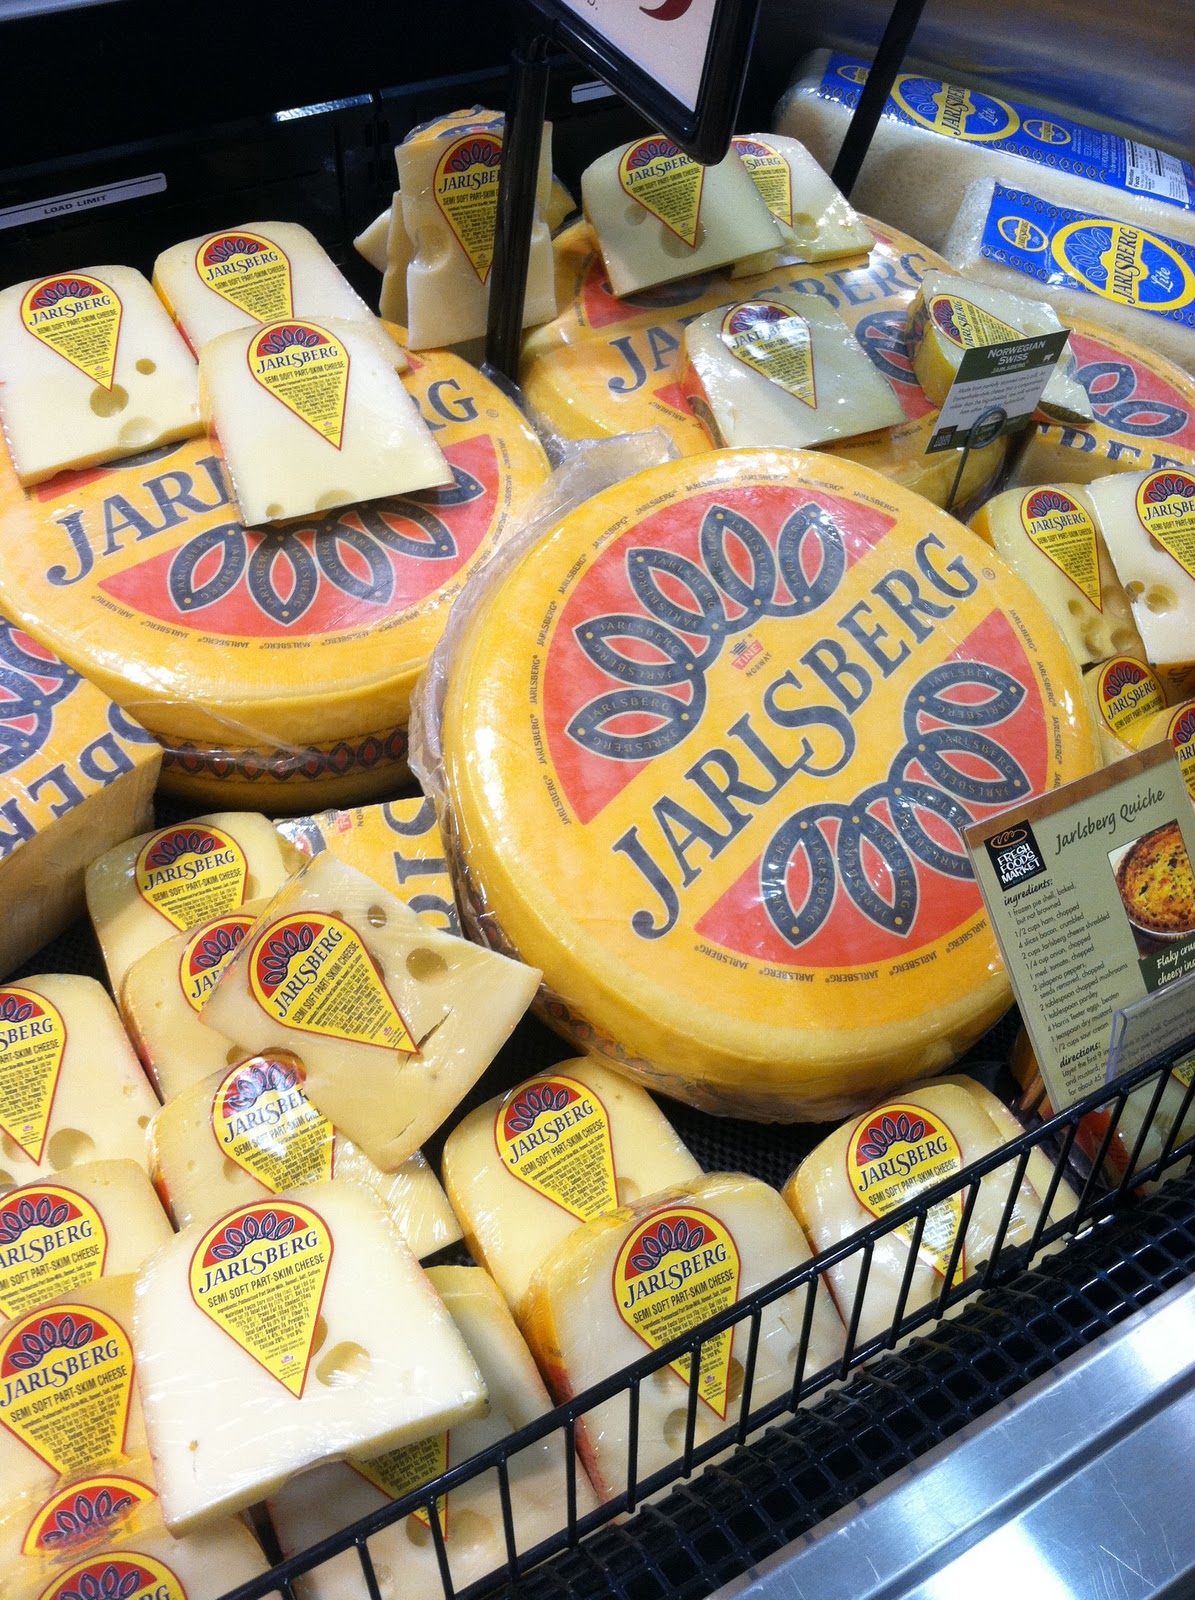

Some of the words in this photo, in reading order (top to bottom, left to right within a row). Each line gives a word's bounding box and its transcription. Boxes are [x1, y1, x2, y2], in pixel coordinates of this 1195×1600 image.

[941, 86, 965, 135] JARLSBER
[978, 107, 999, 126] Lite
[744, 157, 781, 169] SBERG
[439, 170, 500, 194] JARLSBE
[44, 203, 73, 214] LOAD
[77, 195, 107, 207] LIMIT
[206, 251, 278, 281] JARLSBERG
[1112, 227, 1140, 304] JARLSBERG
[1151, 267, 1174, 292] Lite
[29, 295, 111, 326] JARLSBERG
[257, 346, 338, 373] JARLSBERG
[988, 341, 1046, 359] NORWEGIAN
[998, 353, 1028, 365] SWISS
[1030, 513, 1086, 534] JARLSBERG
[1144, 503, 1195, 521] JARLSBE
[745, 652, 772, 678] NORWAY
[1108, 680, 1156, 720] JARLSBERG
[611, 531, 979, 940] JARLSBERG
[1055, 812, 1116, 855] Jarlsberg
[1120, 788, 1165, 823] Quiche
[144, 850, 235, 890] JARLSBERG
[997, 843, 1030, 866] FRESH
[1001, 853, 1036, 875] FOODS
[152, 890, 169, 902] SEMI
[169, 885, 185, 897] SOFT
[186, 876, 218, 892] PART-SKIM
[219, 868, 243, 882] CHEESE
[1002, 859, 1040, 884] MARKET
[1004, 879, 1053, 907] ingredients:
[1013, 904, 1032, 916] frozen
[1032, 899, 1041, 908] pie
[1015, 928, 1026, 938] 1/2
[1028, 923, 1040, 935] cups
[1056, 902, 1080, 919] chopped
[1017, 916, 1026, 925] but
[1027, 911, 1035, 920] not
[1036, 899, 1061, 916] browned
[1024, 936, 1038, 947] slices
[1060, 912, 1084, 929] crumbled
[1028, 947, 1040, 958] cups
[1041, 934, 1066, 952] Jarlsberg
[1067, 927, 1085, 939] cheese
[1085, 911, 1110, 930] shredded
[1026, 961, 1037, 970] 1/4
[1039, 956, 1049, 965] cup
[1068, 933, 1091, 950] chopped
[1071, 944, 1094, 960] chopped
[1157, 950, 1179, 969] Flaky
[273, 926, 344, 1018] JARLSBERG
[292, 1004, 307, 1024] SEMI
[303, 990, 320, 1011] SOFT
[314, 963, 344, 998] PART-SKIM
[339, 941, 360, 966] CHEESE
[1040, 987, 1055, 999] seeds
[1081, 961, 1105, 978] chopped
[1075, 978, 1099, 995] chopped
[1099, 963, 1129, 980] mushrooms
[1158, 966, 1183, 985] cheesy
[1080, 991, 1098, 1006] parsley
[1100, 992, 1120, 1004] beaten
[0, 1018, 53, 1052] SBERG
[1056, 1025, 1081, 1040] teaspoon
[1082, 1018, 1091, 1029] dry
[1092, 1007, 1113, 1021] mustard
[1067, 1035, 1080, 1048] cups
[1081, 1030, 1091, 1040] sour
[1092, 1022, 1109, 1033] cream
[0, 1047, 31, 1064] ART-SKIM
[33, 1039, 60, 1054] CHEESE
[1060, 1041, 1101, 1068] directions:
[1062, 1064, 1077, 1078] Layer
[1077, 1059, 1086, 1068] the
[1066, 1076, 1077, 1087] and
[1068, 1086, 1077, 1096] for
[1078, 1076, 1093, 1091] about
[224, 1088, 309, 1143] JARLSBE
[509, 1099, 594, 1165] JARLSBERG
[520, 1161, 537, 1176] SEMI
[538, 1151, 553, 1167] SOFT
[551, 1131, 582, 1157] PART-SKIM
[582, 1119, 605, 1139] CHEESE
[233, 1140, 252, 1157] SEMI
[859, 1135, 948, 1192] JARLSBERG
[868, 1190, 885, 1206] SEMI
[885, 1183, 901, 1198] SOFT
[901, 1169, 934, 1190] PART-SKIM
[934, 1158, 958, 1177] CHEESE
[0, 1220, 93, 1270] ARLSBERG
[10, 1271, 30, 1287] SOFT
[32, 1256, 71, 1280] PART-SKIM
[72, 1244, 101, 1264] CHEESE
[198, 1230, 319, 1294] JARLSBERG
[623, 1243, 727, 1309] JARLSBERG
[207, 1292, 228, 1308] SEMI
[230, 1283, 250, 1301] SOFT
[251, 1266, 295, 1292] PART-SKIM
[295, 1252, 325, 1273] CHEESE
[633, 1307, 652, 1324] SEMI
[652, 1298, 671, 1316] SOFT
[671, 1282, 708, 1307] PART-SKIM
[708, 1268, 735, 1292] CHEESE
[0, 1339, 119, 1408] JARLSBERG
[10, 1408, 32, 1424] SEMI
[33, 1396, 52, 1415] SOFT
[53, 1377, 98, 1405] PART-SKIM
[98, 1365, 128, 1387] CHEESE
